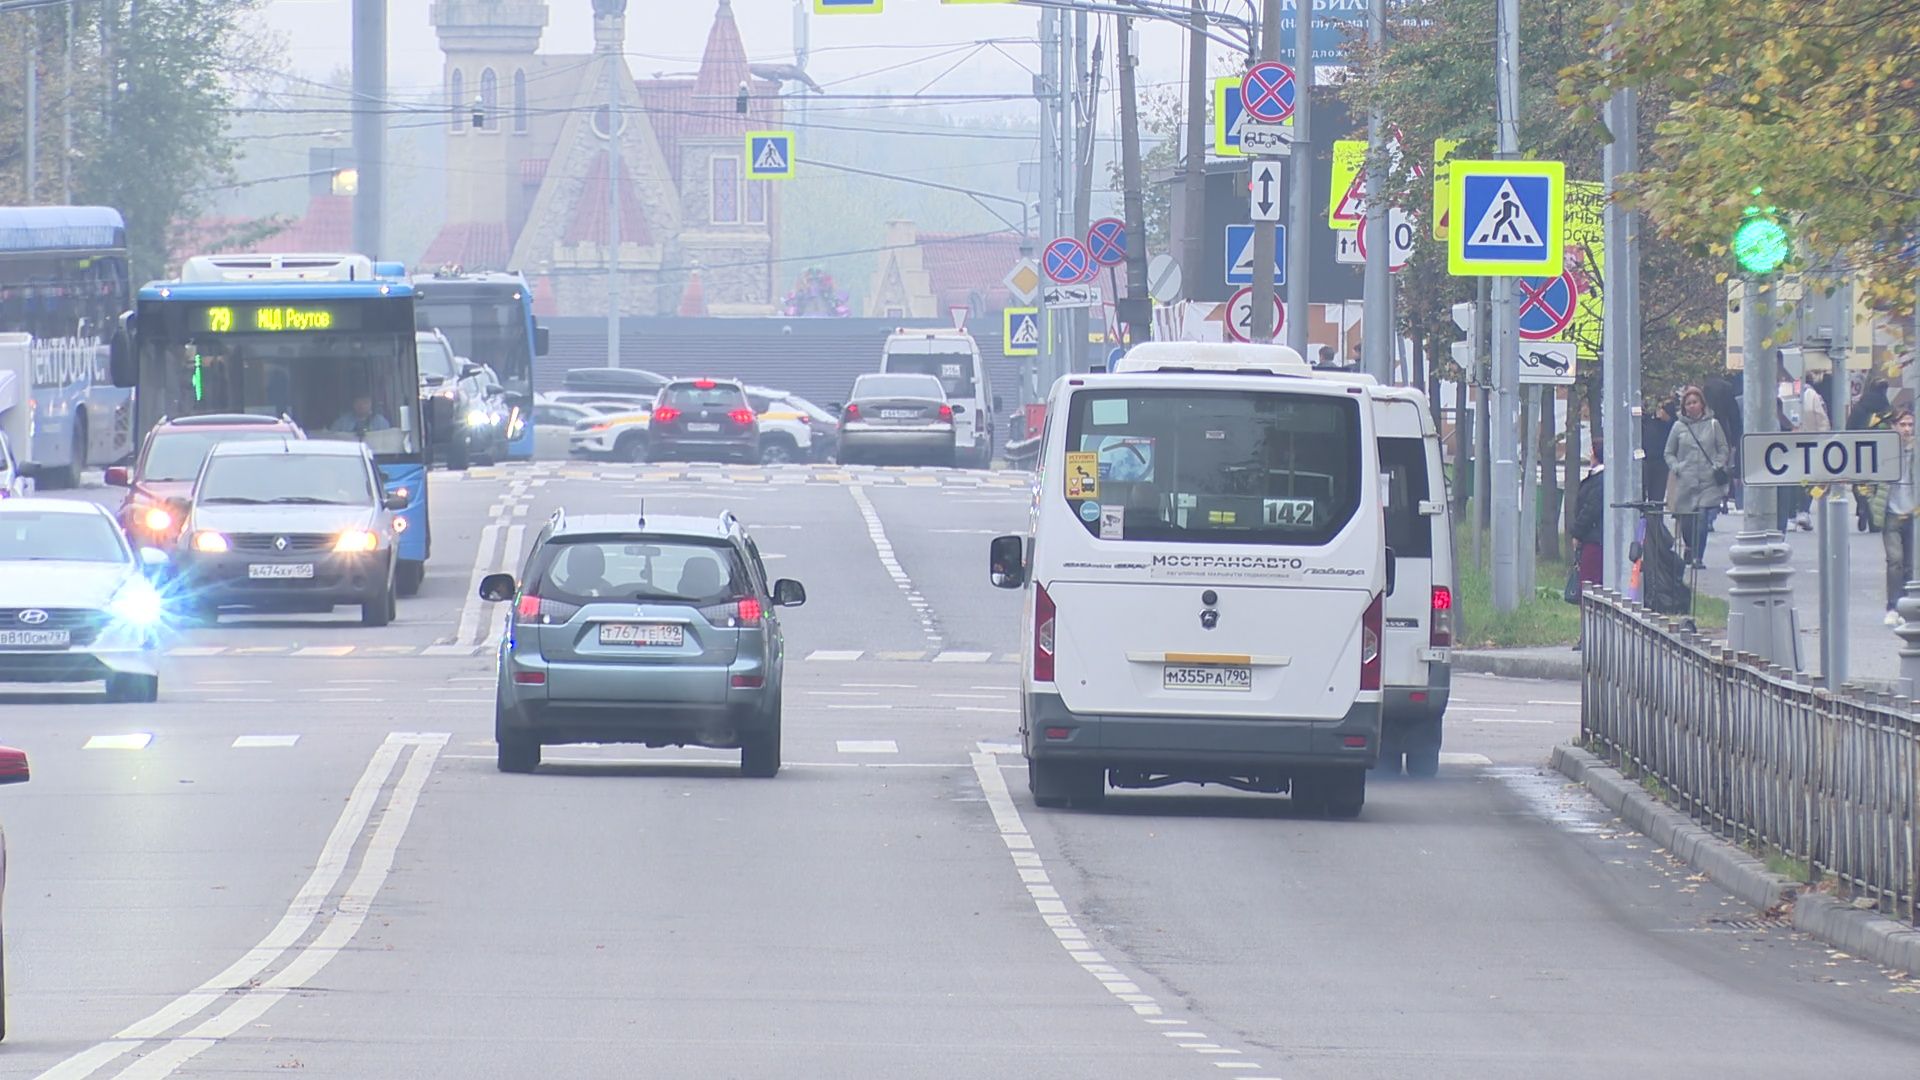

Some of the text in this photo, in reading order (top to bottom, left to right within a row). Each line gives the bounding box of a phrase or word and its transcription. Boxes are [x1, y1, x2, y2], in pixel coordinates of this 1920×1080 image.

[1564, 229, 1600, 243] ОСТЬ
[209, 307, 231, 331] 79
[286, 308, 330, 330] Реутов
[1240, 305, 1252, 327] 2
[1765, 441, 1878, 475] СТОП
[1264, 502, 1313, 525] 142
[1152, 555, 1302, 569] МОСТРАНСАВТО
